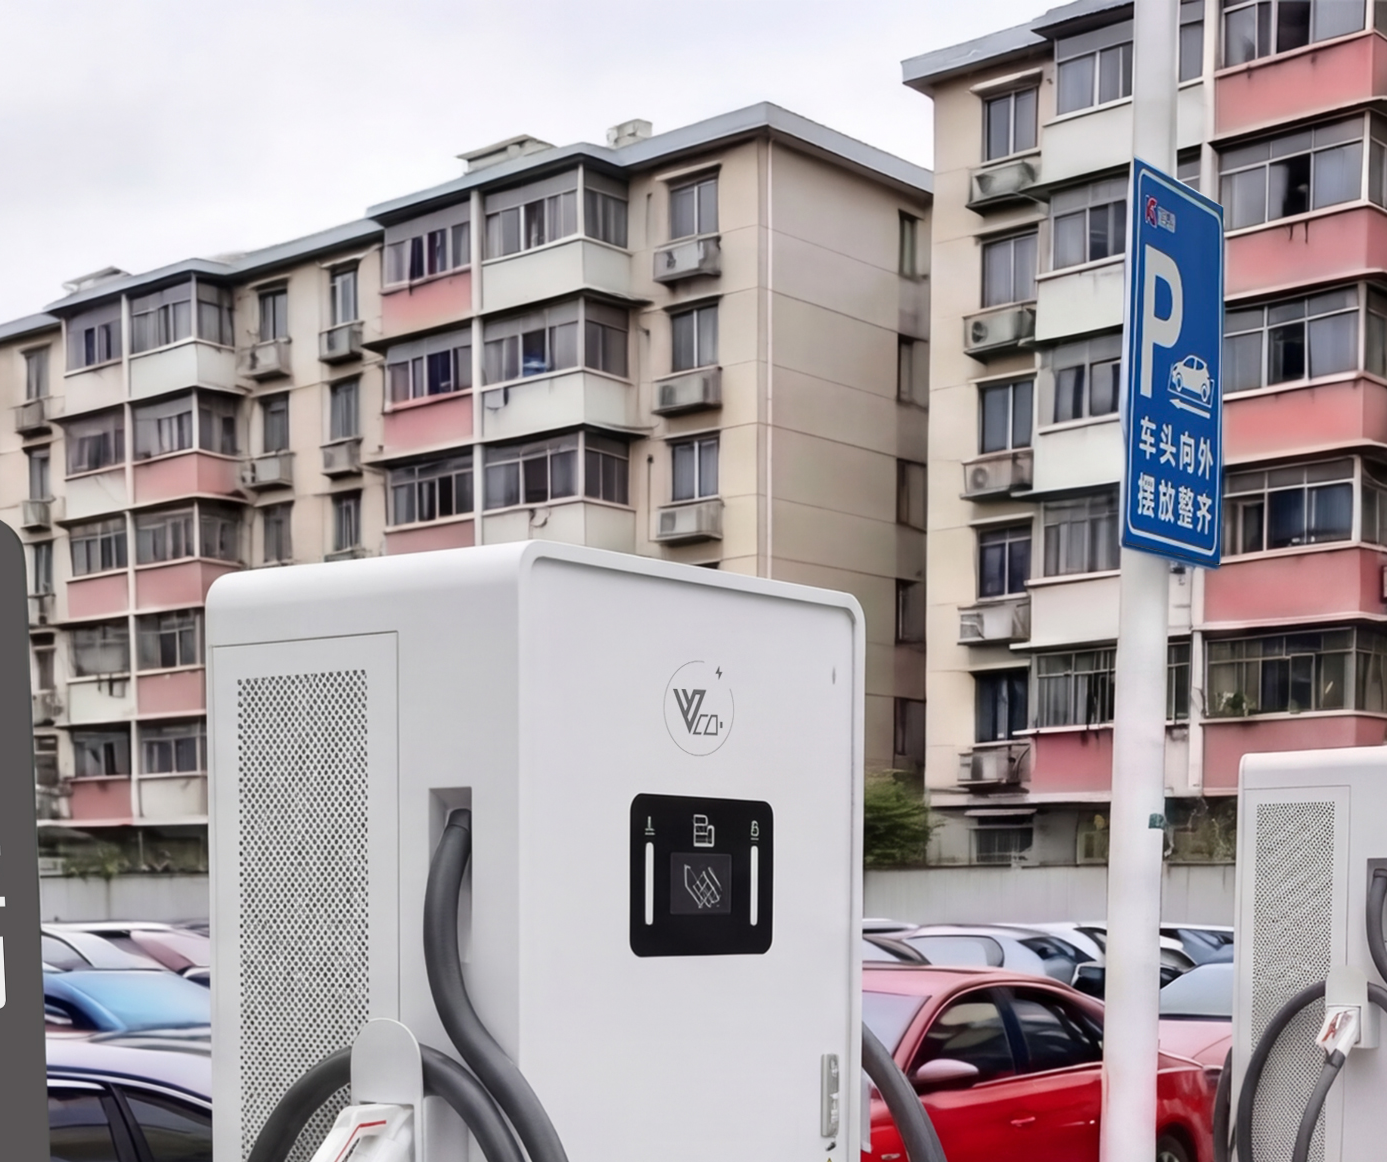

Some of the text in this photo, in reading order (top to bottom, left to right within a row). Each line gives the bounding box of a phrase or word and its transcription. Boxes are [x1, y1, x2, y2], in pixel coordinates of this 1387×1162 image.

[1140, 244, 1183, 399] P
[1138, 415, 1214, 480] 车头向外
[1137, 472, 1213, 535] 摆放整齐
